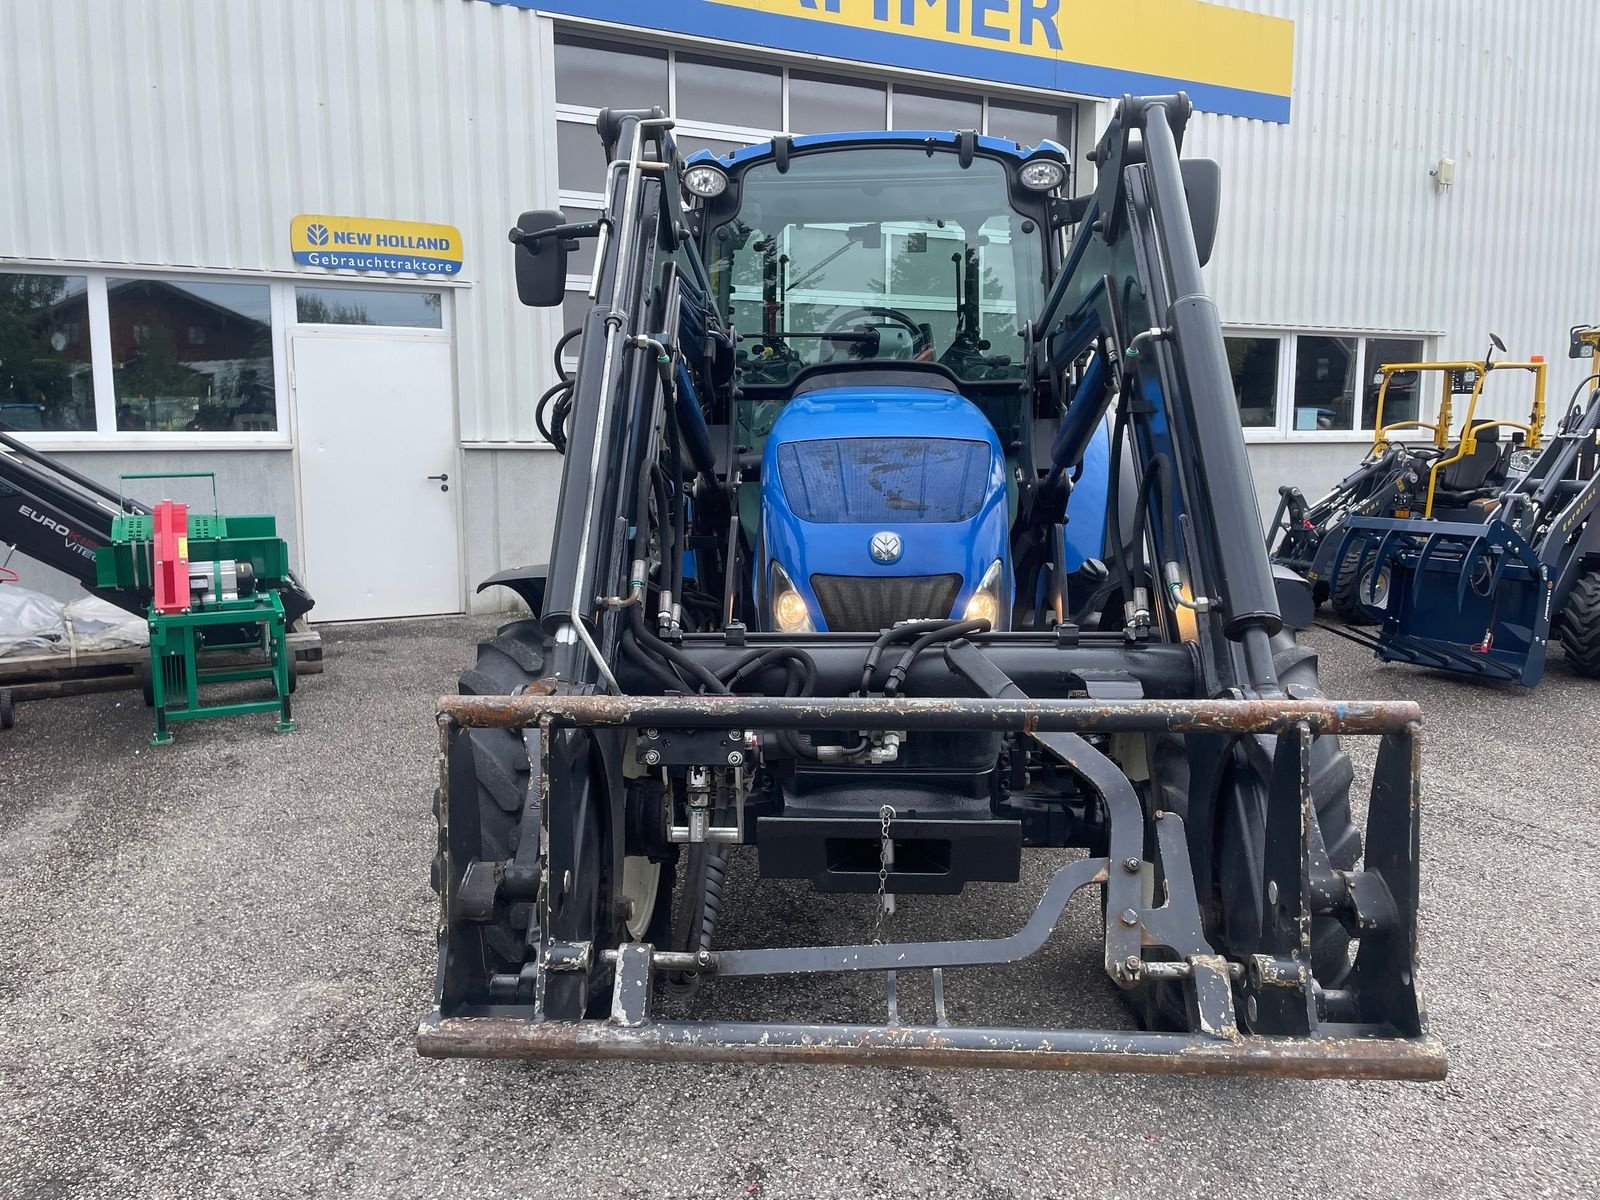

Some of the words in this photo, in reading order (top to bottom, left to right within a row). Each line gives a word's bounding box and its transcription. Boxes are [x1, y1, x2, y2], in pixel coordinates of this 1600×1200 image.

[333, 231, 371, 246] NEW
[376, 233, 450, 251] HOLLAND
[308, 252, 453, 273] Gebrauchttraktore
